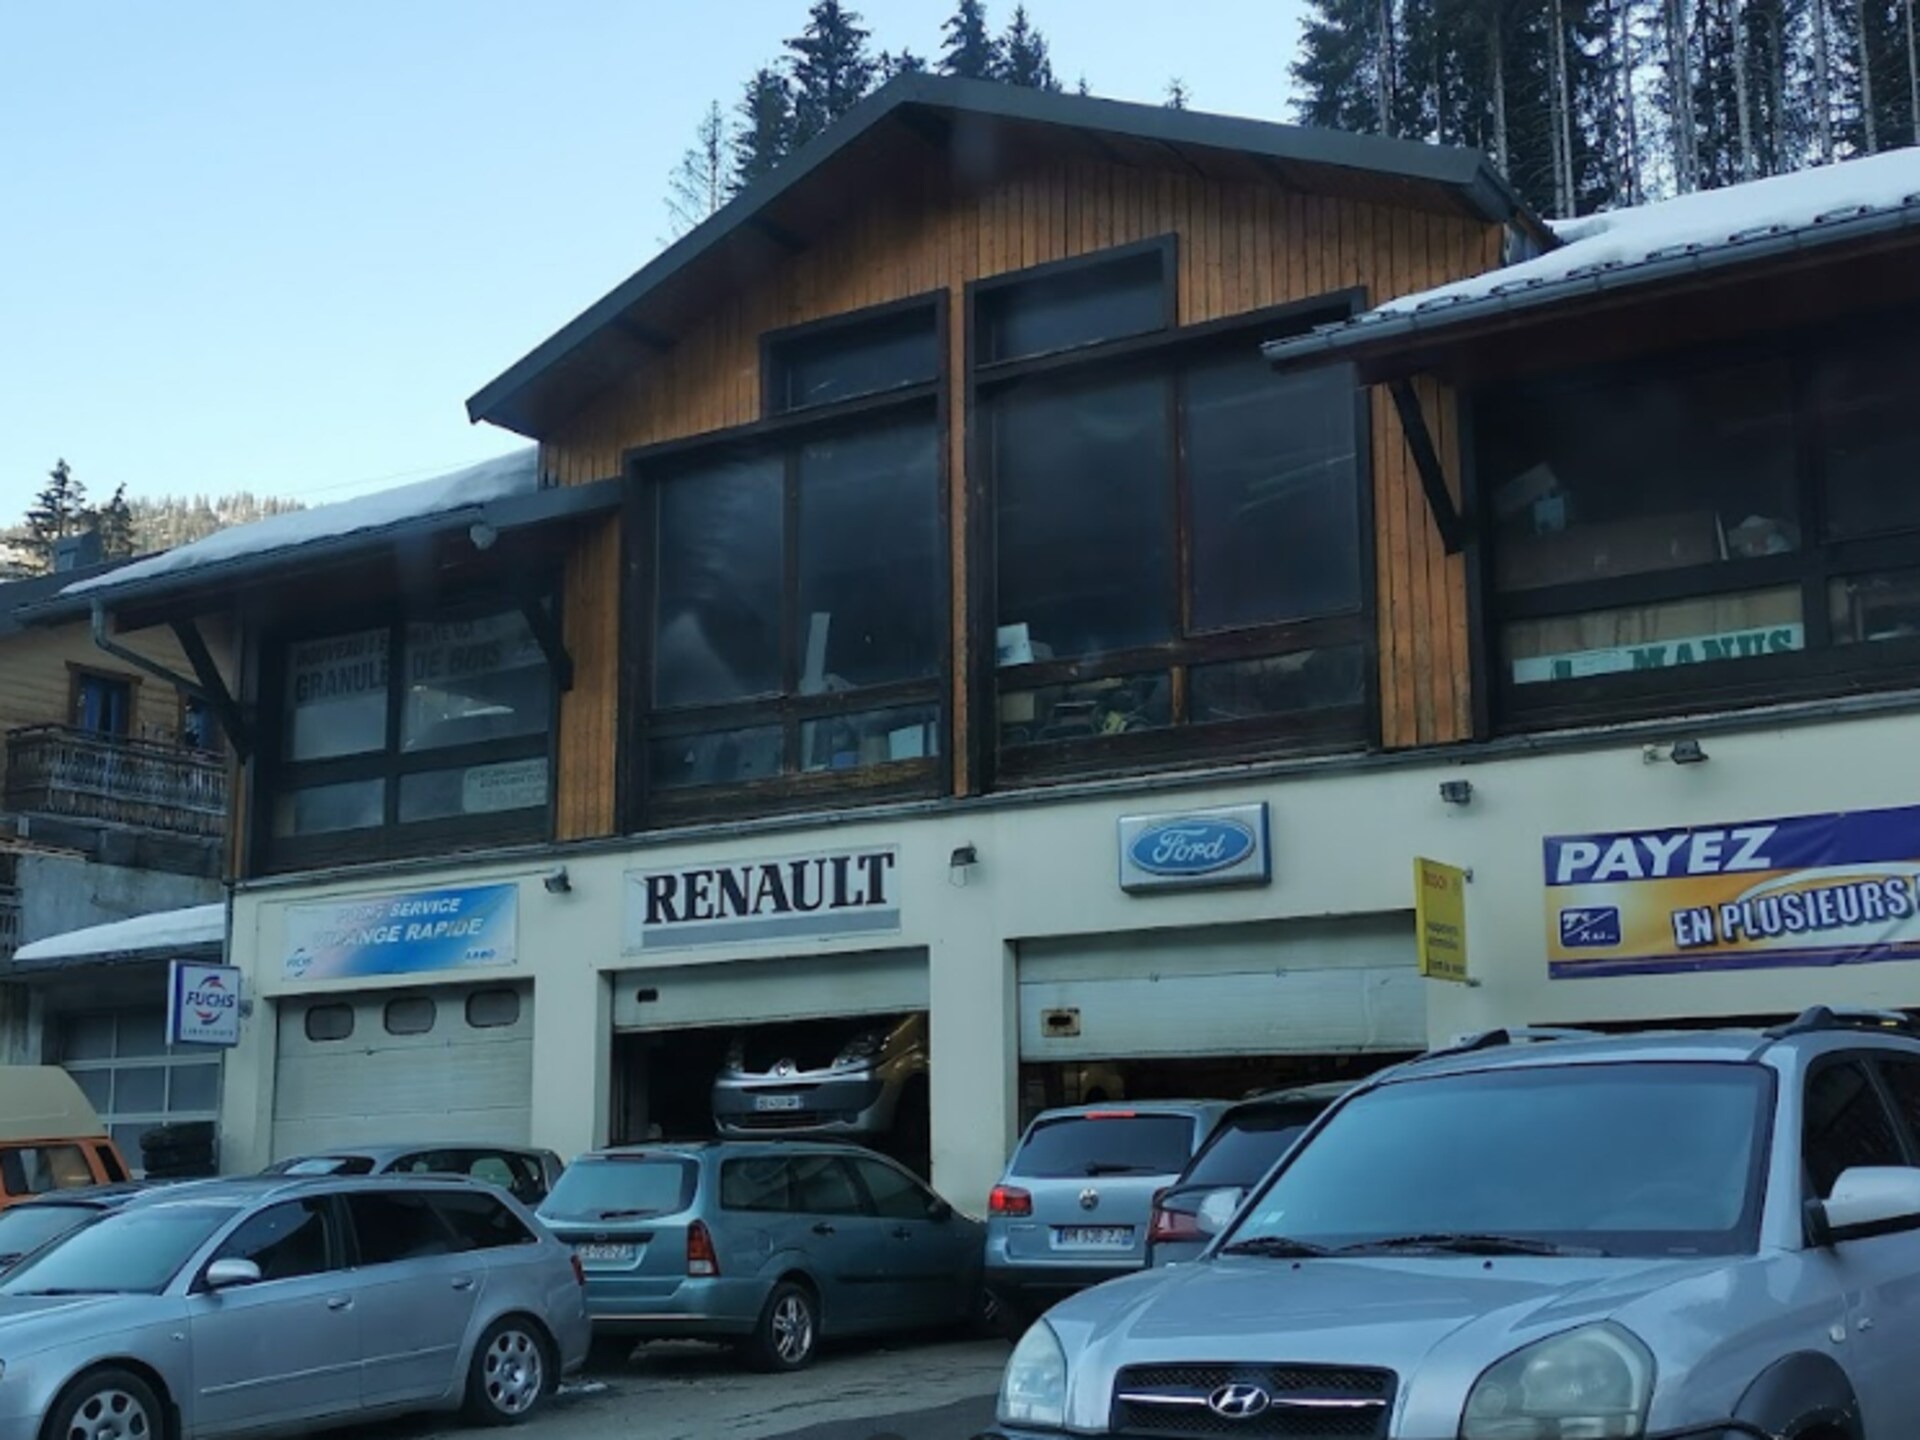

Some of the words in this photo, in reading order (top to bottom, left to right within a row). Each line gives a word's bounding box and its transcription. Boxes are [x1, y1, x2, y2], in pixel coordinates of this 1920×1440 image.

[1151, 827, 1227, 865] Ford
[1556, 825, 1778, 883] PAYEZ
[389, 897, 463, 918] SERVICE
[641, 851, 896, 926] RENAULT
[404, 917, 484, 942] RAPIDE
[1672, 907, 1714, 947] EN
[1719, 878, 1909, 940] PLUSIEURS
[185, 989, 236, 1008] FUCHS
